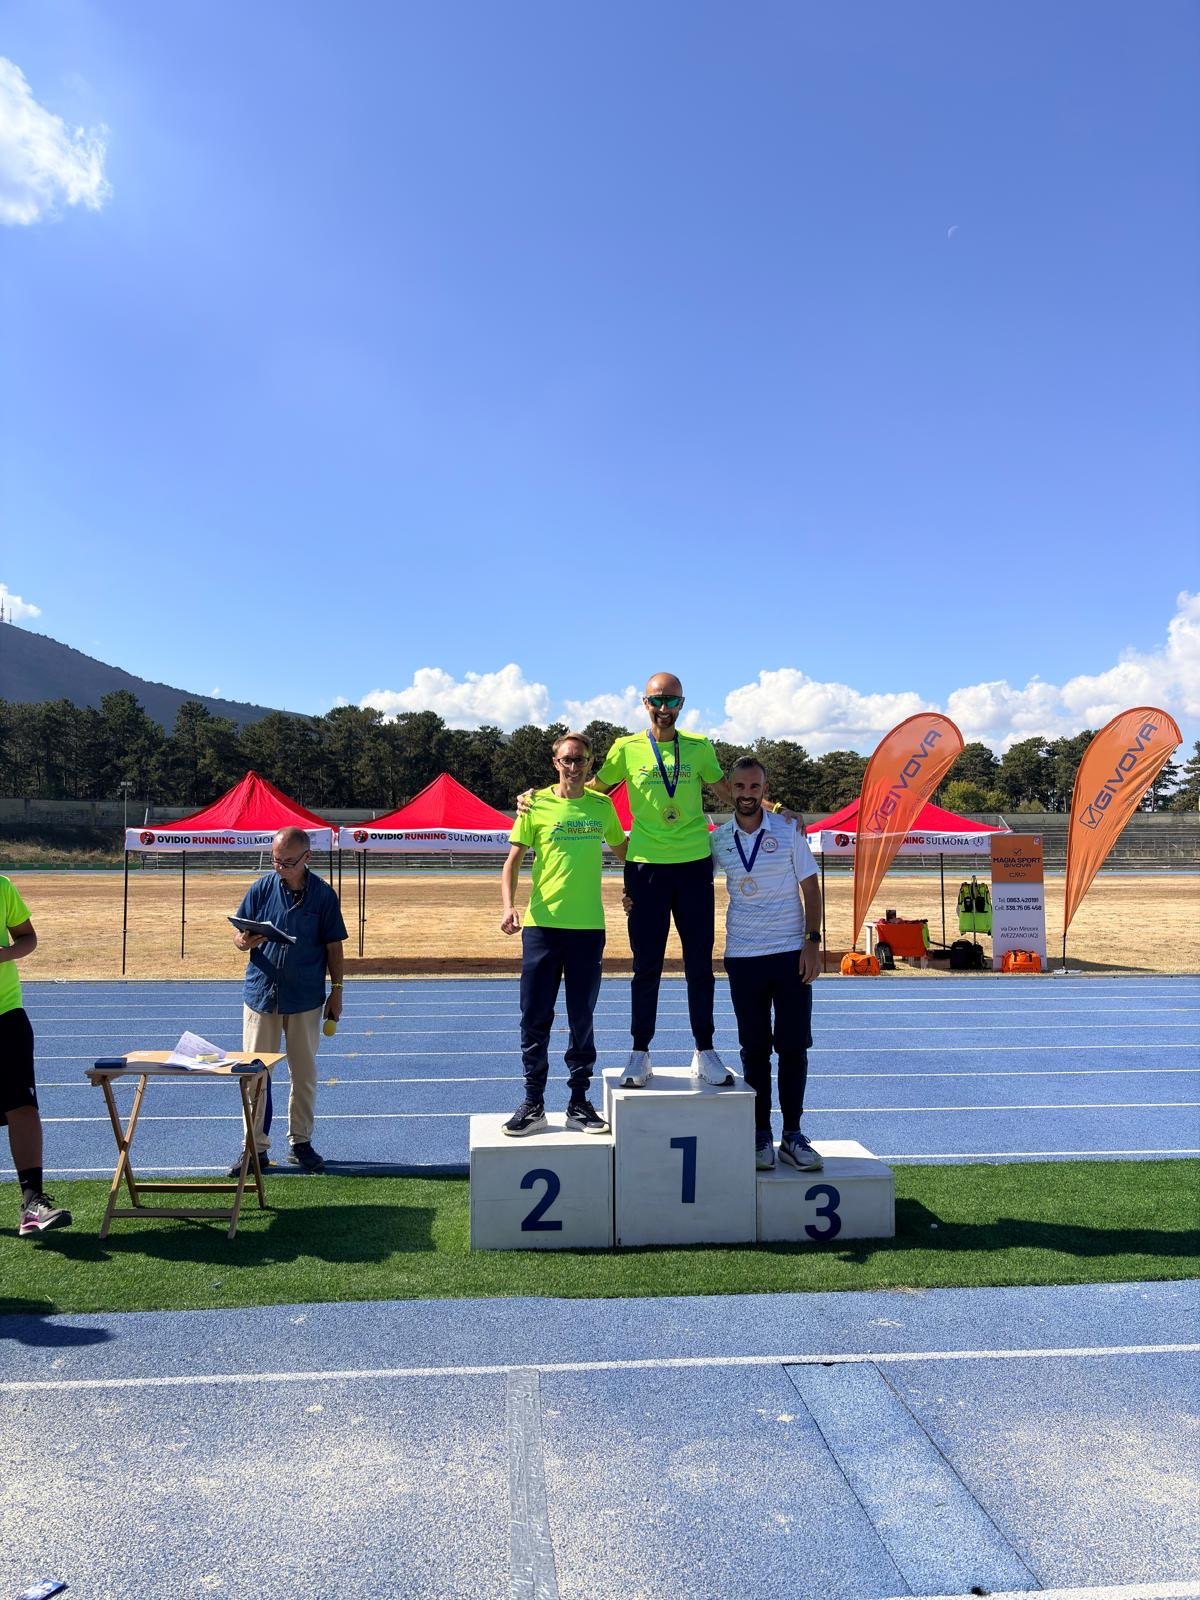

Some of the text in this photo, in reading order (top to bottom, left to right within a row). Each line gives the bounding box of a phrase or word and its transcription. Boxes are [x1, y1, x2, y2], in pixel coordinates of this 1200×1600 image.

[880, 730, 942, 816] GIVOVA
[1094, 723, 1158, 810] GIVOVA
[157, 835, 191, 844] OVIDIO
[192, 836, 235, 845] RUNNING
[370, 832, 493, 843] OVIDIO RUNNING SULMONA
[567, 820, 603, 828] RUNNERS
[926, 837, 970, 846] SULMONA
[670, 1136, 697, 1204] 1
[520, 1168, 563, 1232] 2
[804, 1184, 842, 1242] 3
